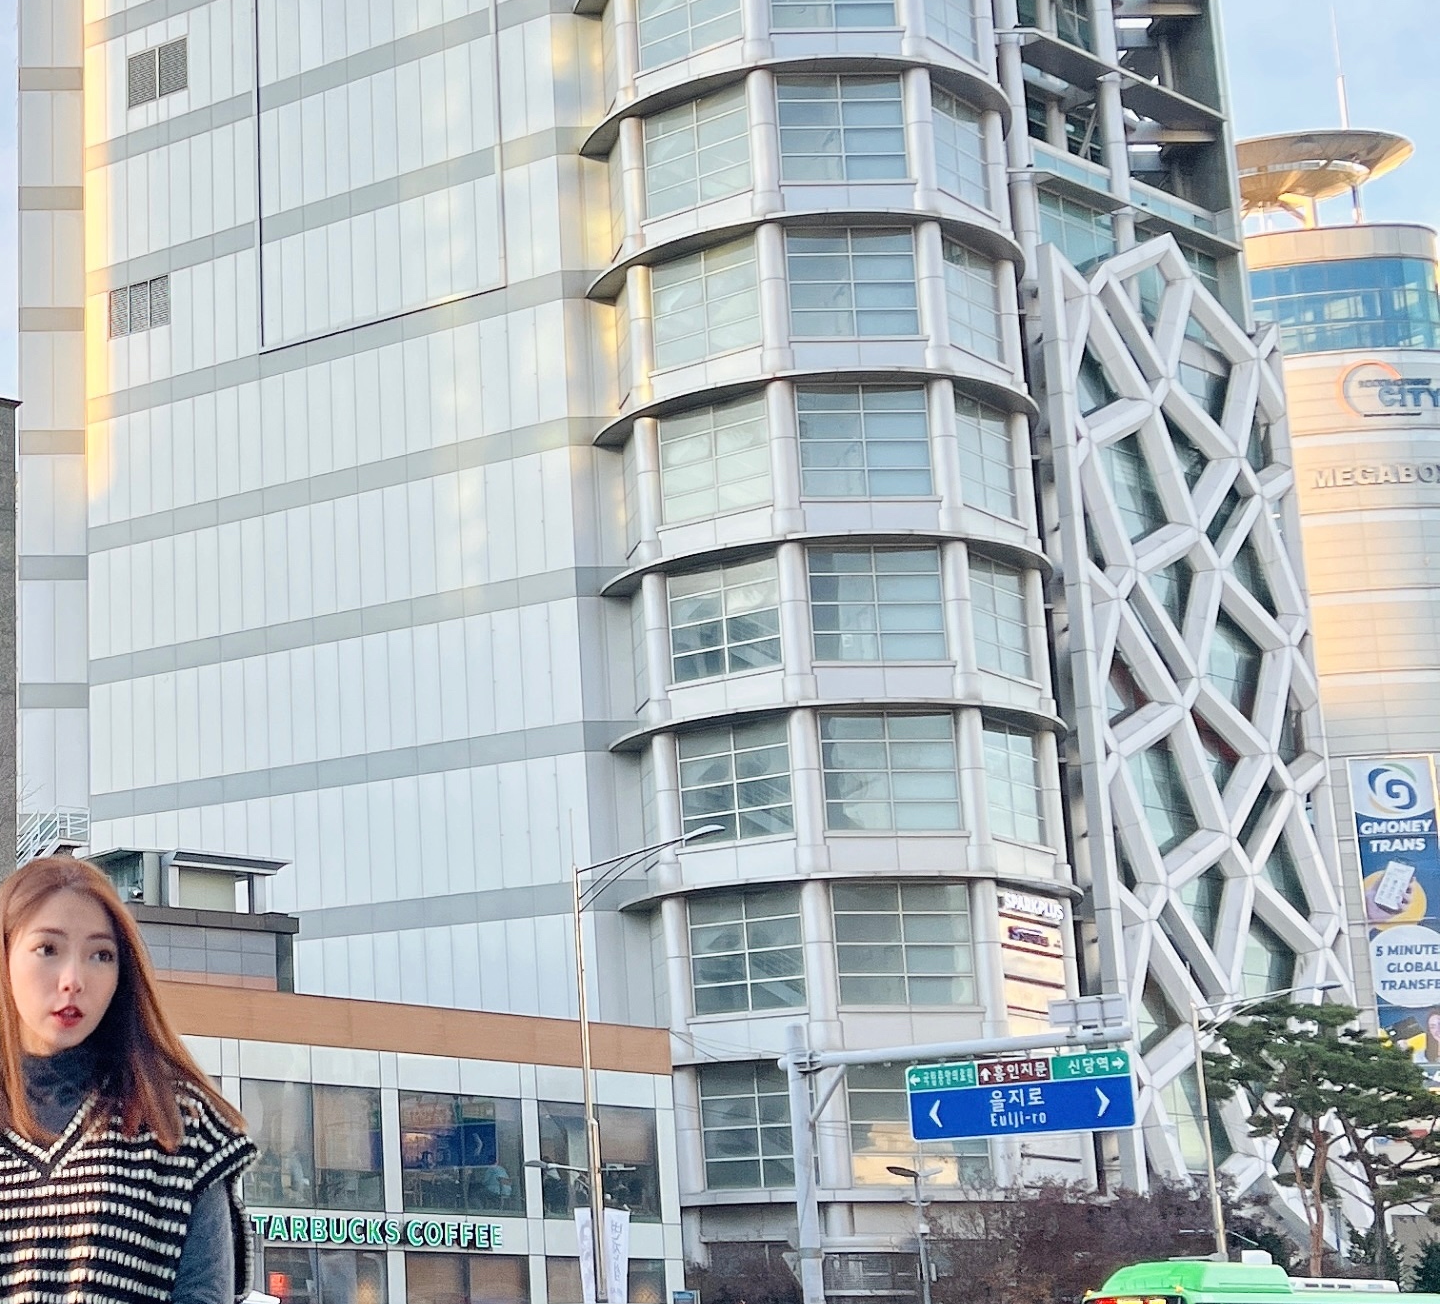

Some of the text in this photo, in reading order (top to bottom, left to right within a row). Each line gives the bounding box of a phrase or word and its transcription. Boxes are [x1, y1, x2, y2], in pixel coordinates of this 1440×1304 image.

[1313, 463, 1440, 488] MEGABO
[1360, 819, 1433, 834] GMONEY
[1369, 838, 1426, 852] TRANS
[1375, 944, 1440, 957] 5 MINUTE
[1387, 961, 1440, 974] GLOBAL
[1380, 979, 1440, 991] TRANSFE
[993, 1061, 1048, 1083] 흥인지문
[1068, 1056, 1110, 1075] 신당역
[989, 1087, 1046, 1113] 을지로
[990, 1110, 1047, 1129] Eulji-ro
[251, 1214, 503, 1248] TARBUCKS COFFEE
